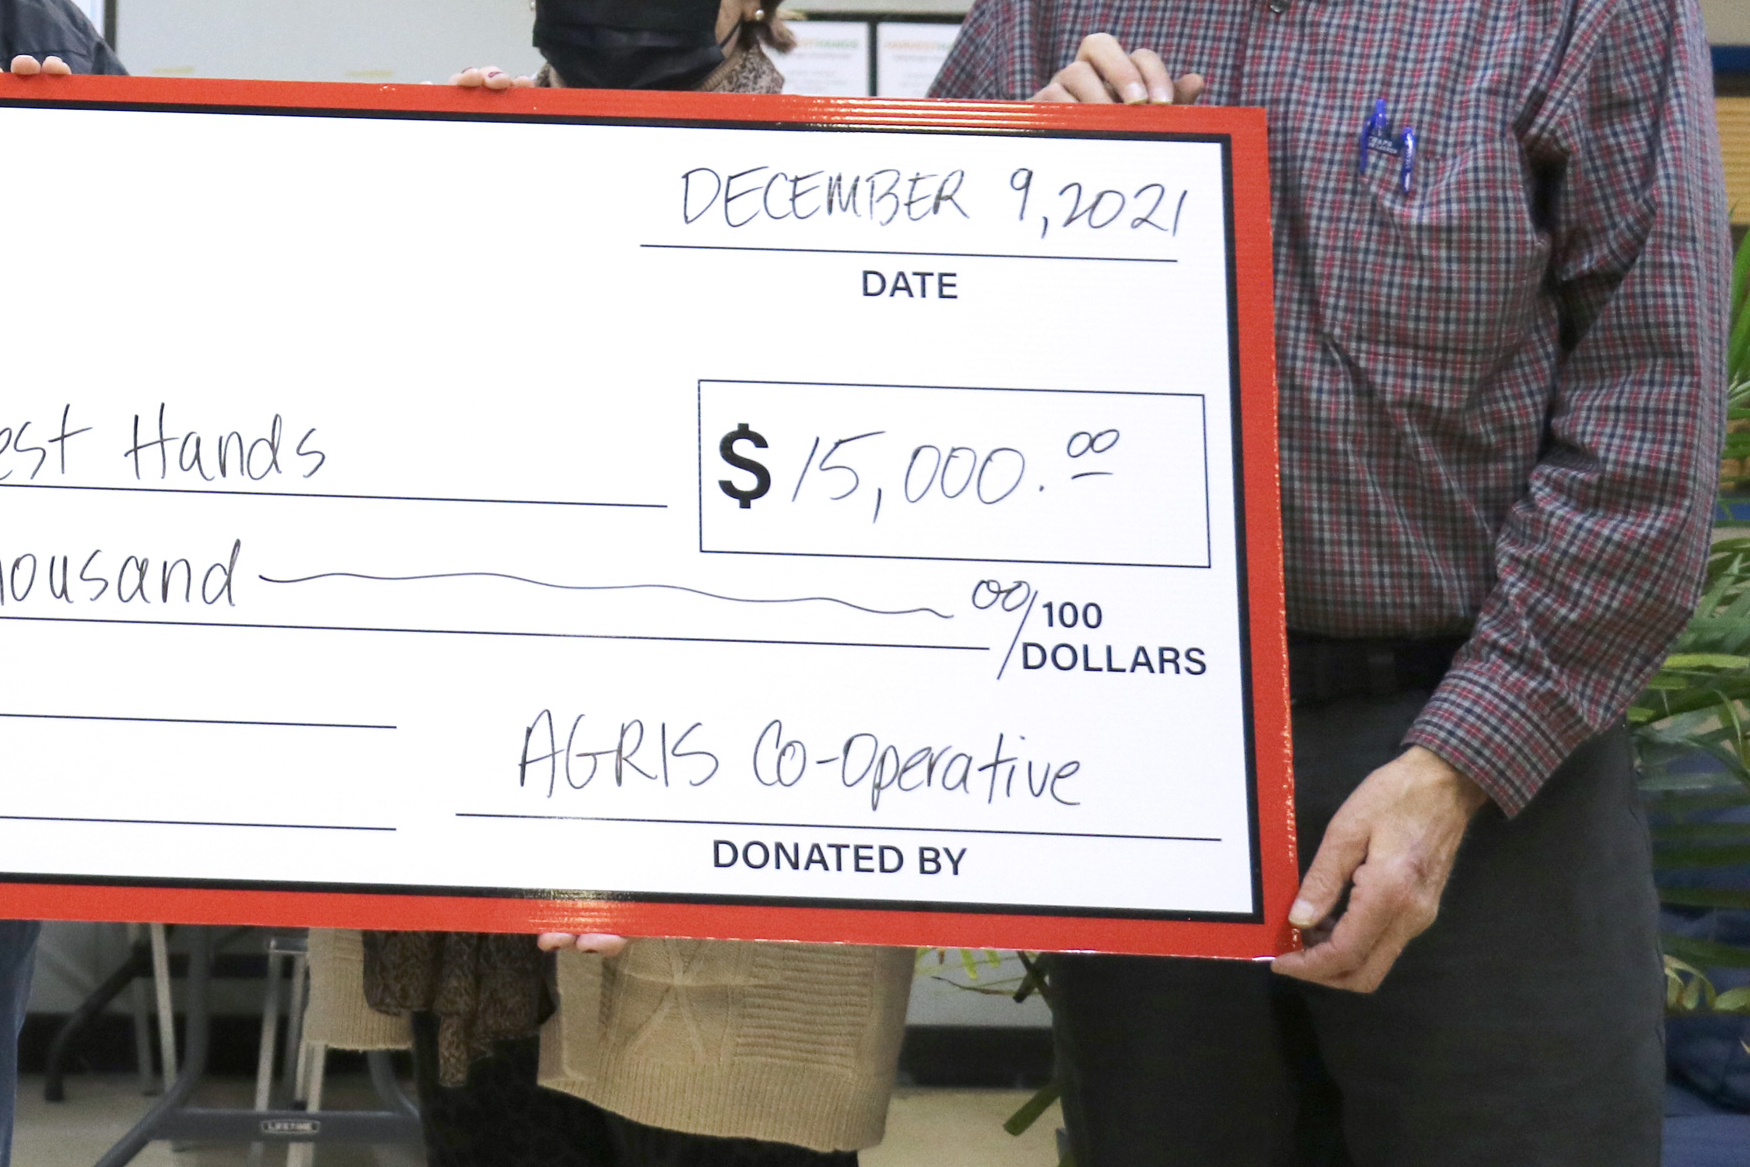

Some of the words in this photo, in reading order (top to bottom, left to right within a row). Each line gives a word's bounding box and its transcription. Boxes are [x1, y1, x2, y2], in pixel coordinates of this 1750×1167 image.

[681, 166, 967, 228] DECEMBER
[863, 270, 958, 299] DATE
[123, 402, 326, 482] Hands
[718, 423, 771, 509] $
[1022, 642, 1207, 676] DOLLARS
[518, 709, 719, 798] AGRIS
[713, 840, 904, 874] DONATED
[919, 847, 966, 876] BY
